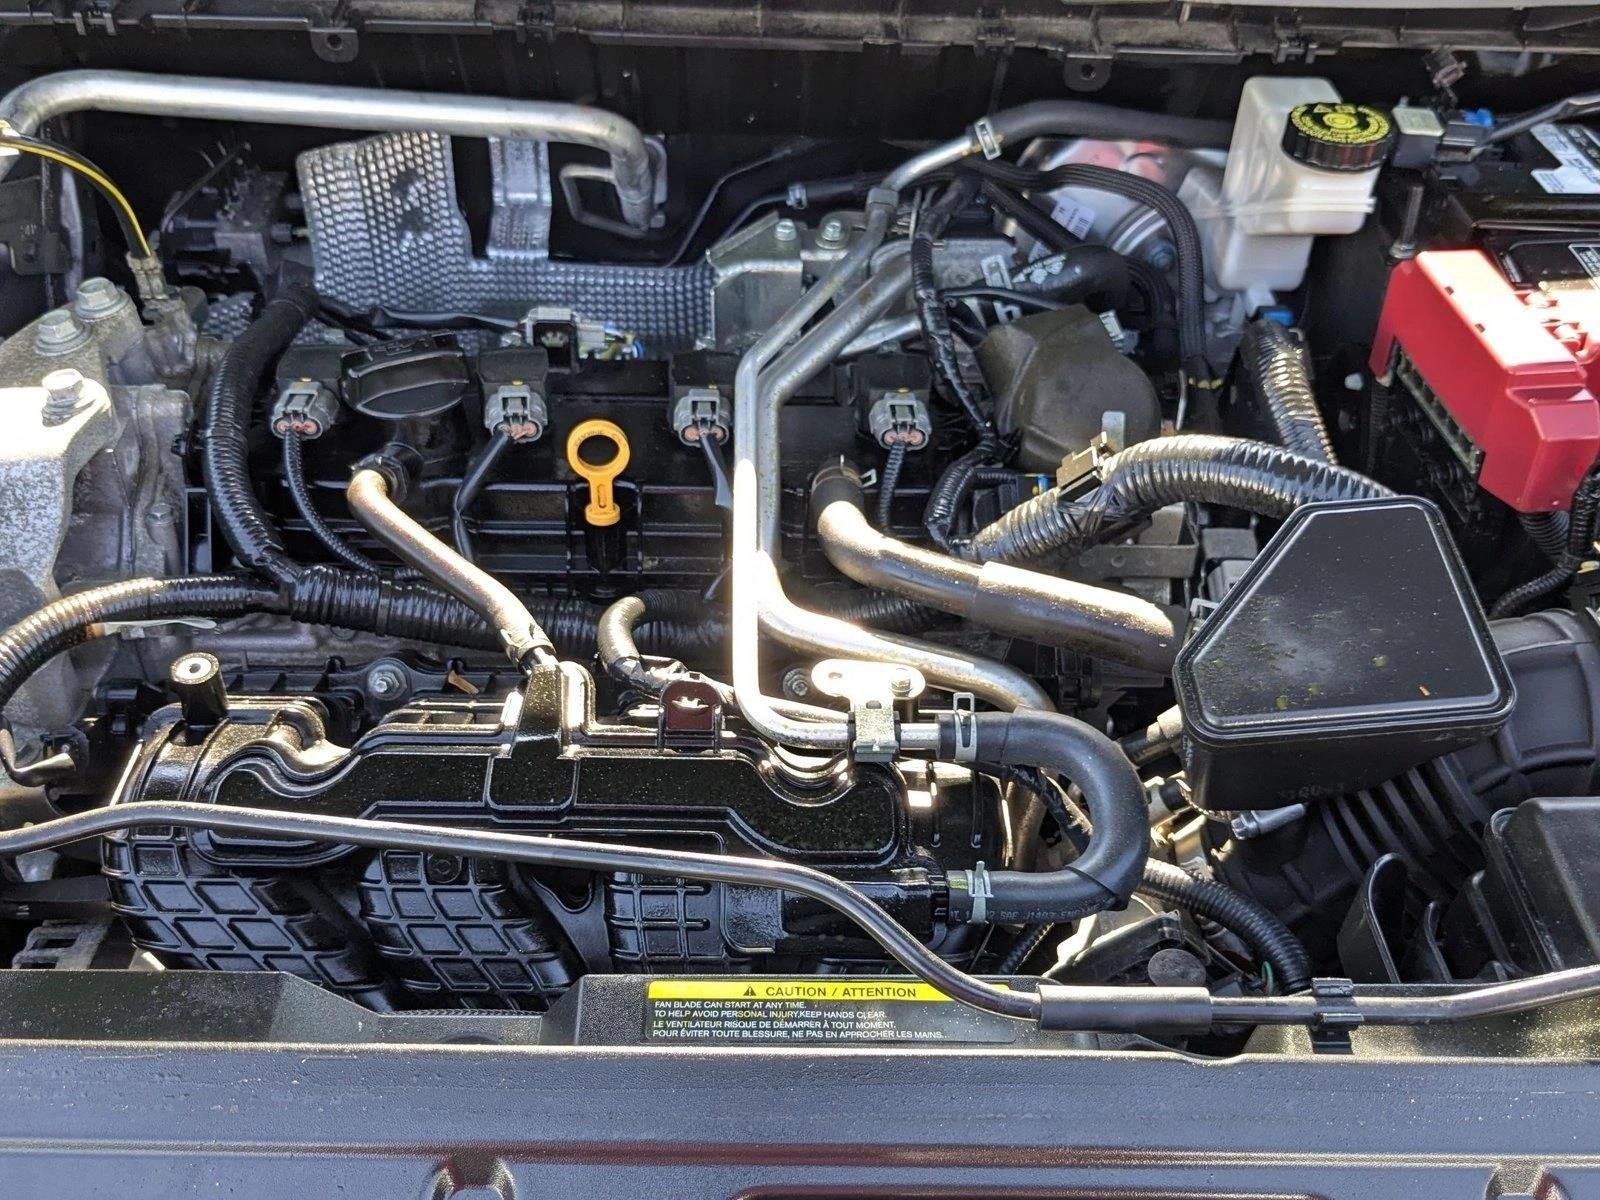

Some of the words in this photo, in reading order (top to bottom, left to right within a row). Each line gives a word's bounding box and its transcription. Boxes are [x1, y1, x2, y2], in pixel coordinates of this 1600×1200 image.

[765, 986, 827, 997] CAUTION
[842, 987, 917, 997] ATTENTION
[654, 1001, 672, 1009] FAN
[673, 1001, 702, 1009] BLADE
[703, 1001, 723, 1009] CAN
[724, 1001, 752, 1009] START
[753, 1001, 763, 1009] AT
[765, 1001, 784, 1009] ANY
[785, 1001, 807, 1009] TIME.
[654, 1010, 666, 1018] TO
[668, 1010, 691, 1018] HELP
[692, 1010, 719, 1018] AVOID
[720, 1010, 768, 1018] PERSONAL
[823, 1011, 854, 1019] HANDS
[856, 1011, 887, 1019] CLEAR.
[653, 1020, 664, 1028] LE
[665, 1020, 722, 1028] VENTILATEUR
[724, 1020, 758, 1029] RISQUE
[758, 1020, 772, 1029] DE
[773, 1019, 821, 1029] DÉMARRER
[822, 1019, 830, 1029] À
[831, 1021, 854, 1029] TOUT
[856, 1020, 896, 1029] MOMENT.
[652, 1029, 679, 1037] POUR
[680, 1028, 710, 1037] ÉVITER
[711, 1030, 740, 1038] TOUTE
[741, 1030, 790, 1039] BLESSURE,
[791, 1030, 804, 1038] NE
[806, 1030, 823, 1038] PAS
[825, 1030, 837, 1038] EN
[839, 1030, 895, 1038] APPROCHER
[896, 1030, 912, 1038] LES
